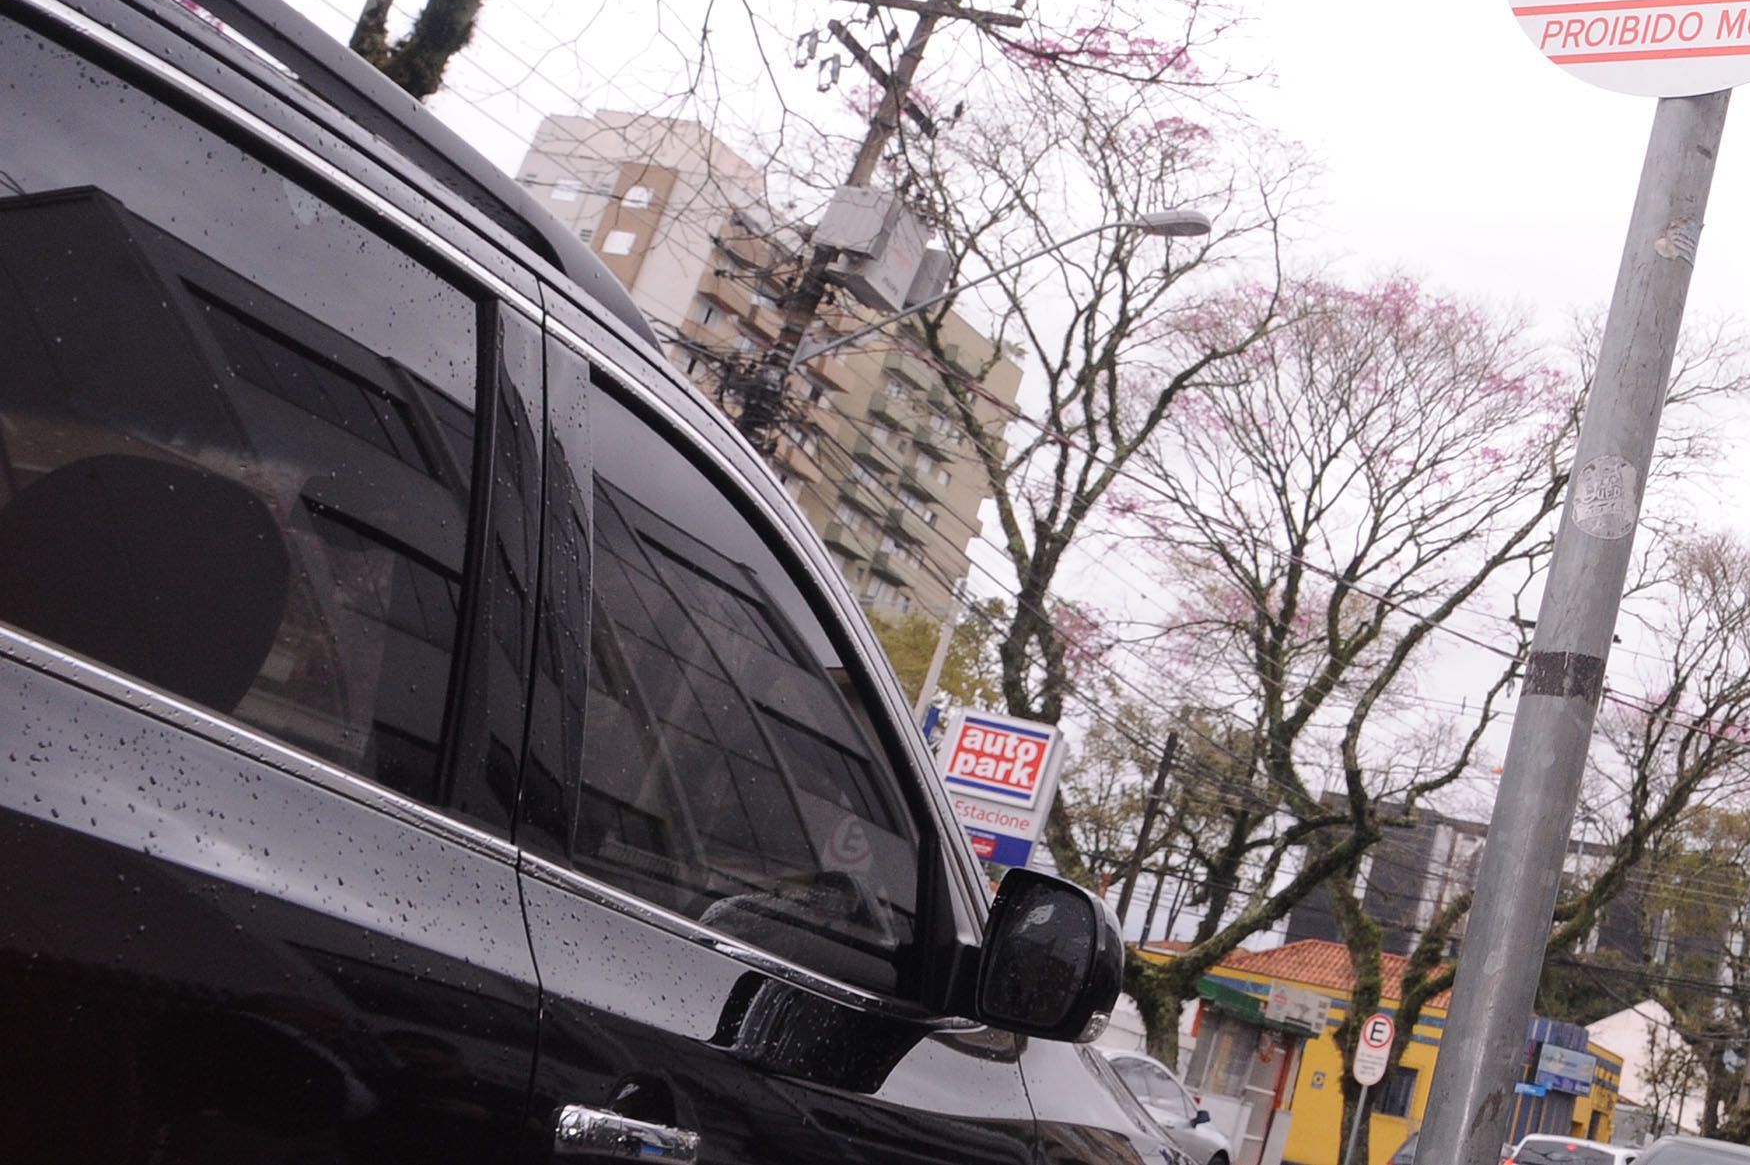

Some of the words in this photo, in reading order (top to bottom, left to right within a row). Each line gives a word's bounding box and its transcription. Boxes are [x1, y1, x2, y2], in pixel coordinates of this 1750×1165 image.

[1540, 10, 1703, 50] PROIBIDO
[961, 728, 1039, 763] auto
[953, 750, 1033, 786] park
[954, 799, 1031, 830] Estacione
[1370, 1021, 1387, 1042] E
